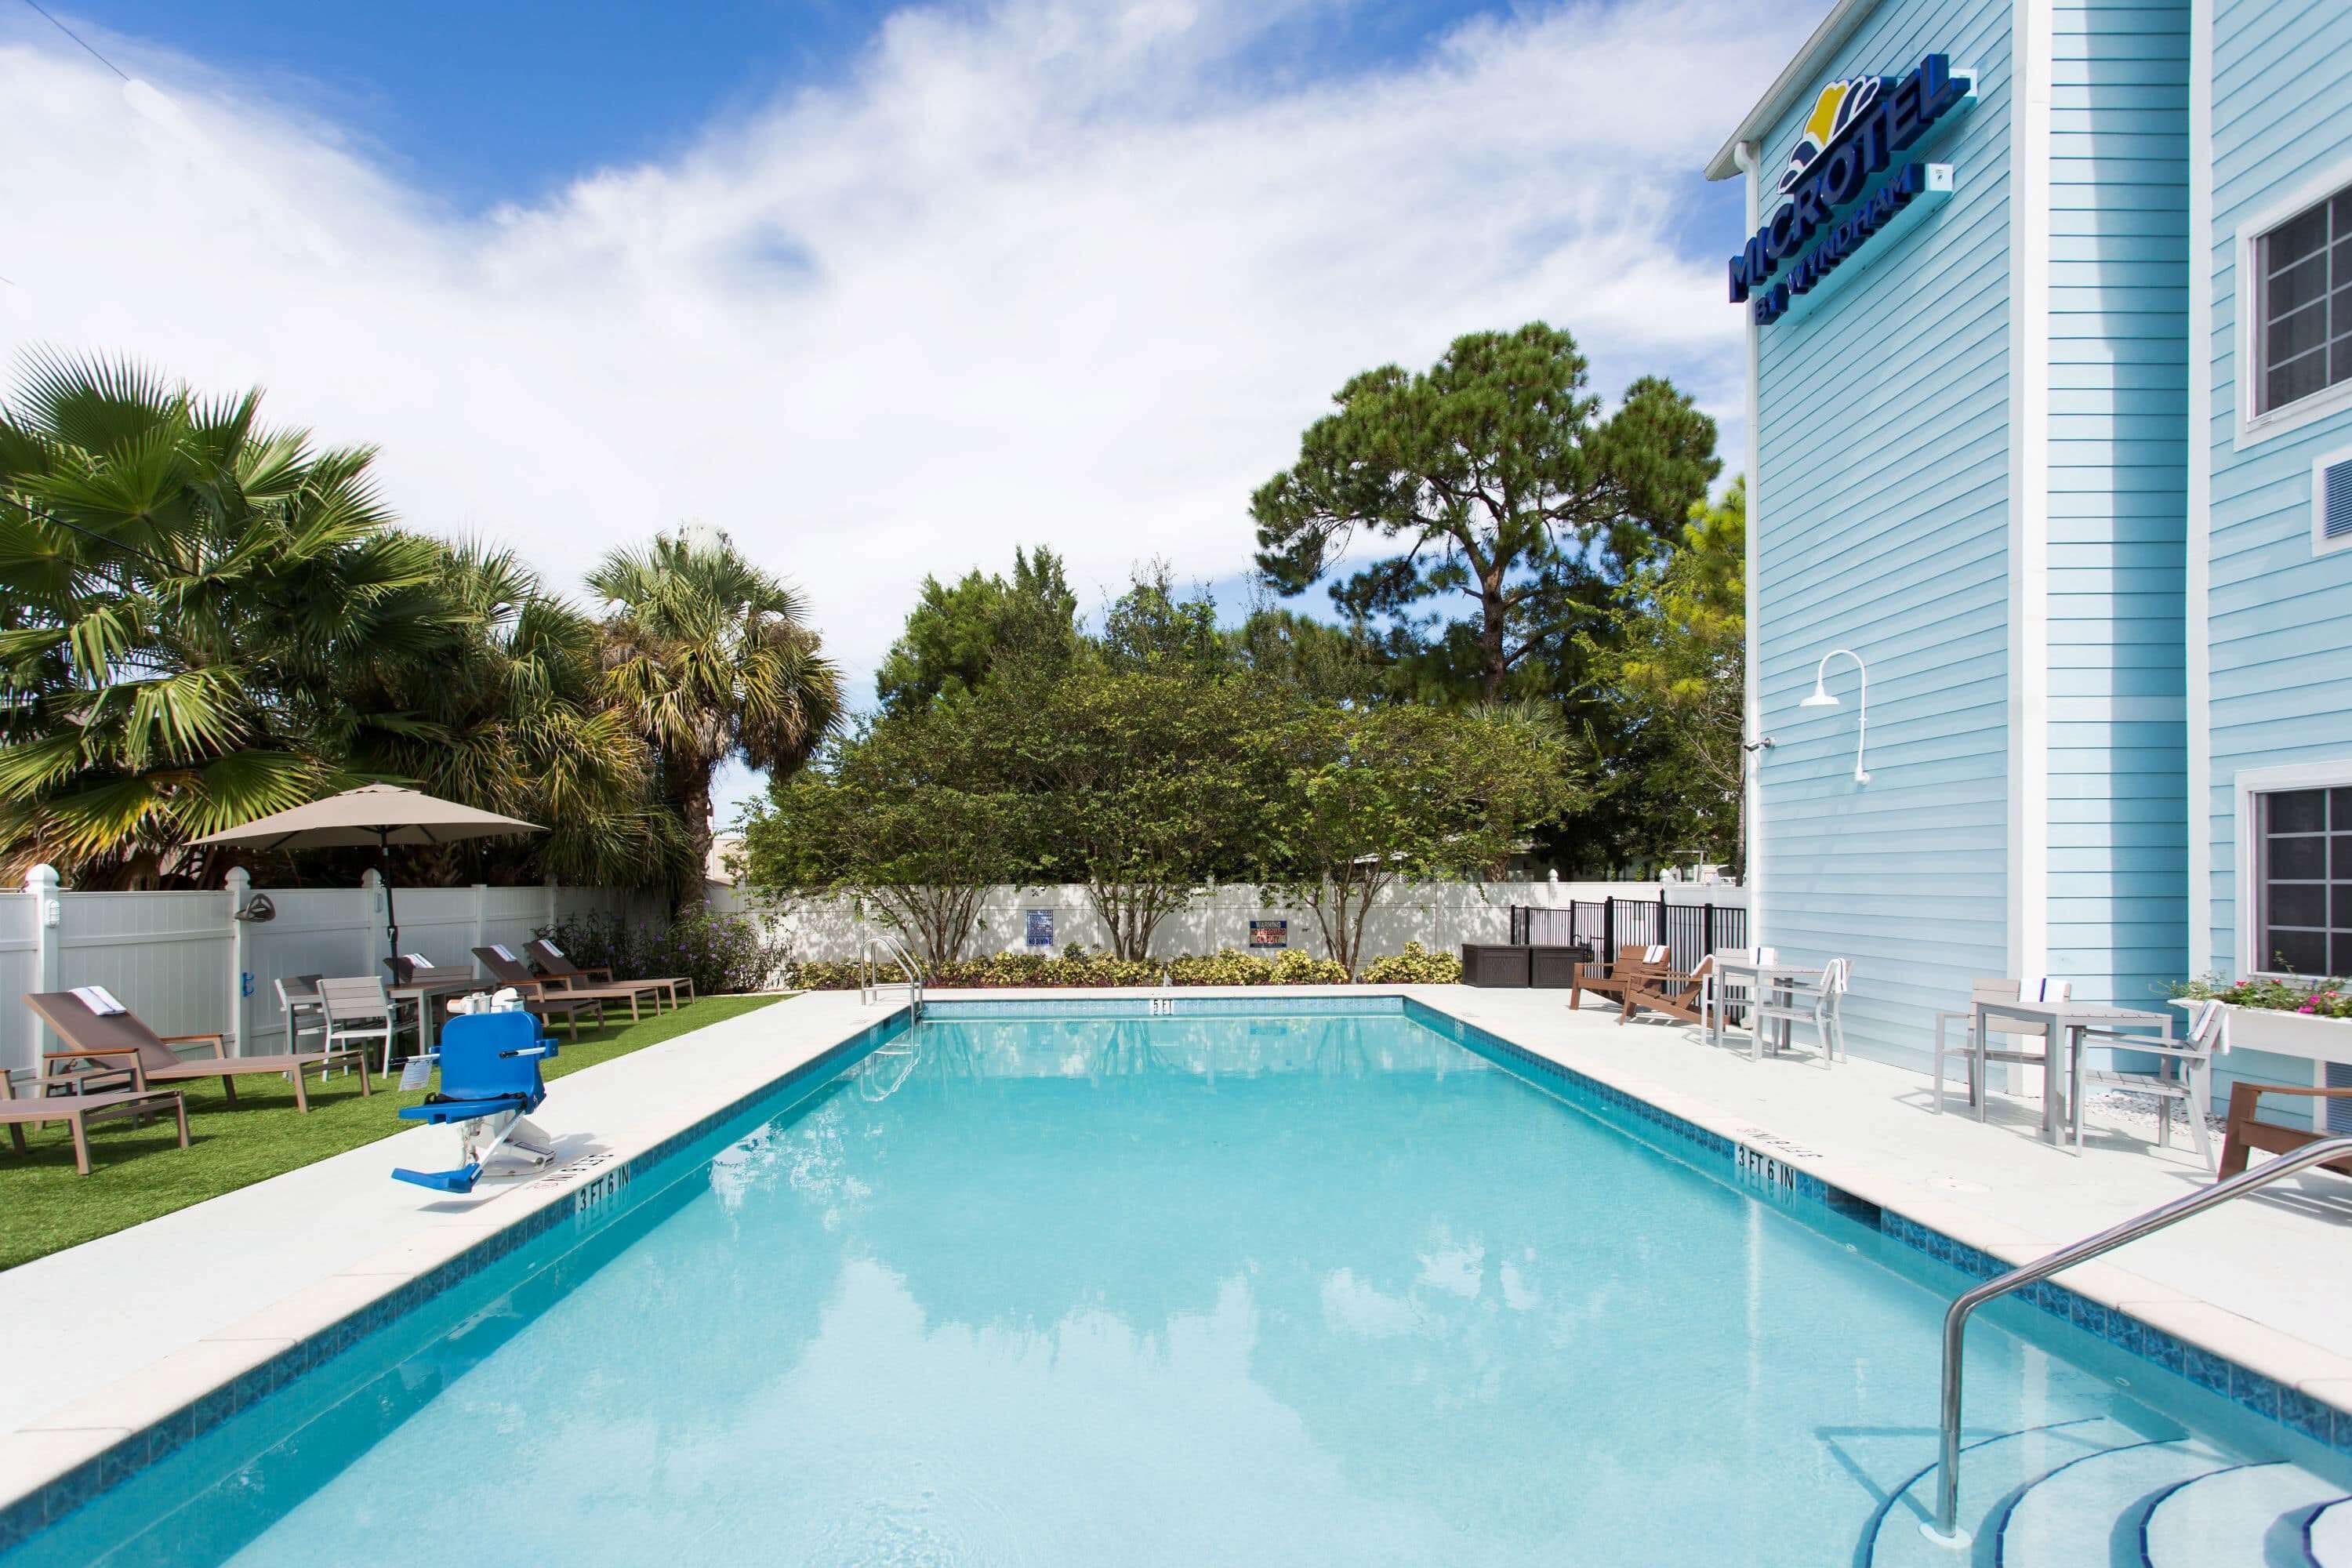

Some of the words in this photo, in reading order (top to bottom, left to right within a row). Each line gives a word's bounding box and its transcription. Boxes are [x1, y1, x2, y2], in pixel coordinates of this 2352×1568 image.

[1730, 54, 1970, 303] MICROTEL
[1787, 163, 1926, 295] WYNDHAM
[1162, 999, 1173, 1009] FT
[580, 1189, 586, 1210] 3
[590, 1178, 604, 1204] FT
[608, 1173, 614, 1195] 6
[619, 1165, 630, 1189] IN
[1739, 1145, 1744, 1166] 3
[1749, 1150, 1762, 1174] FT
[1767, 1160, 1774, 1180] 6
[1780, 1164, 1794, 1189] IN
